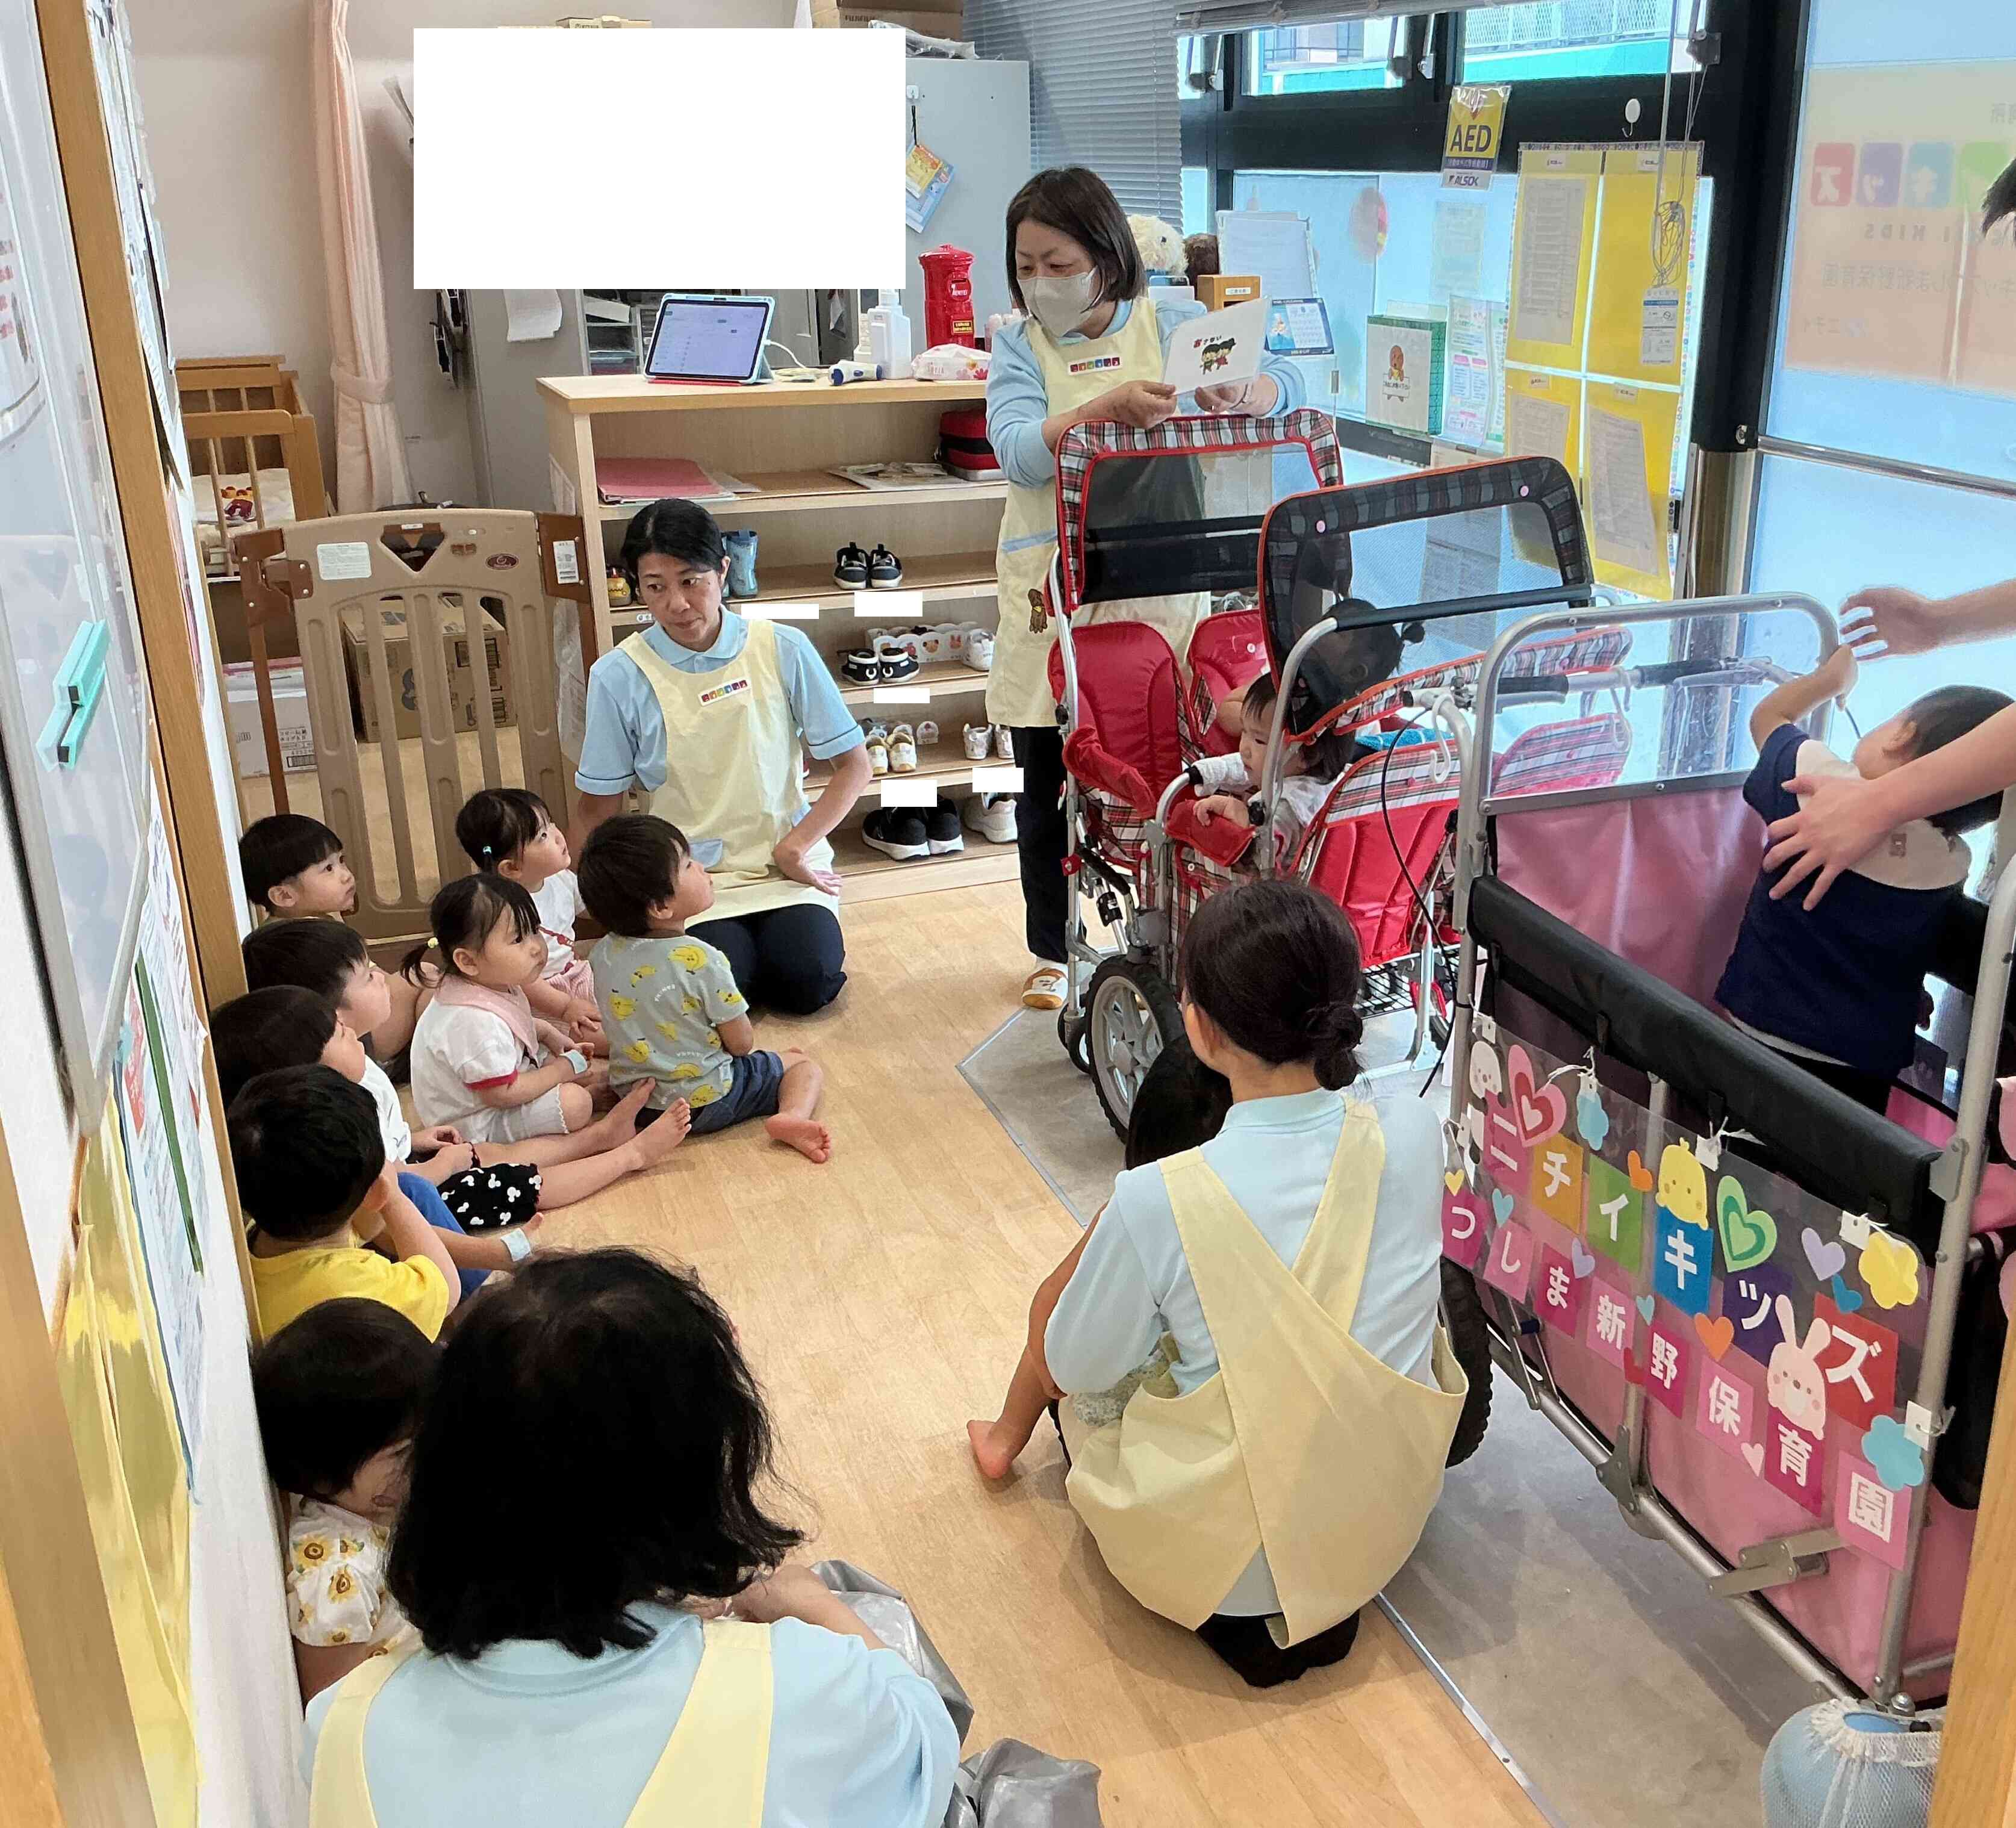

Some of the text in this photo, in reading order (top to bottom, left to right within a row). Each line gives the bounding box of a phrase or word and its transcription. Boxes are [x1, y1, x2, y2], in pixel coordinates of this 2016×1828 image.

[1450, 125, 1492, 153] AED
[1454, 175, 1479, 186] ALSOK
[1450, 1205, 1894, 1543] つしま新野保育園
